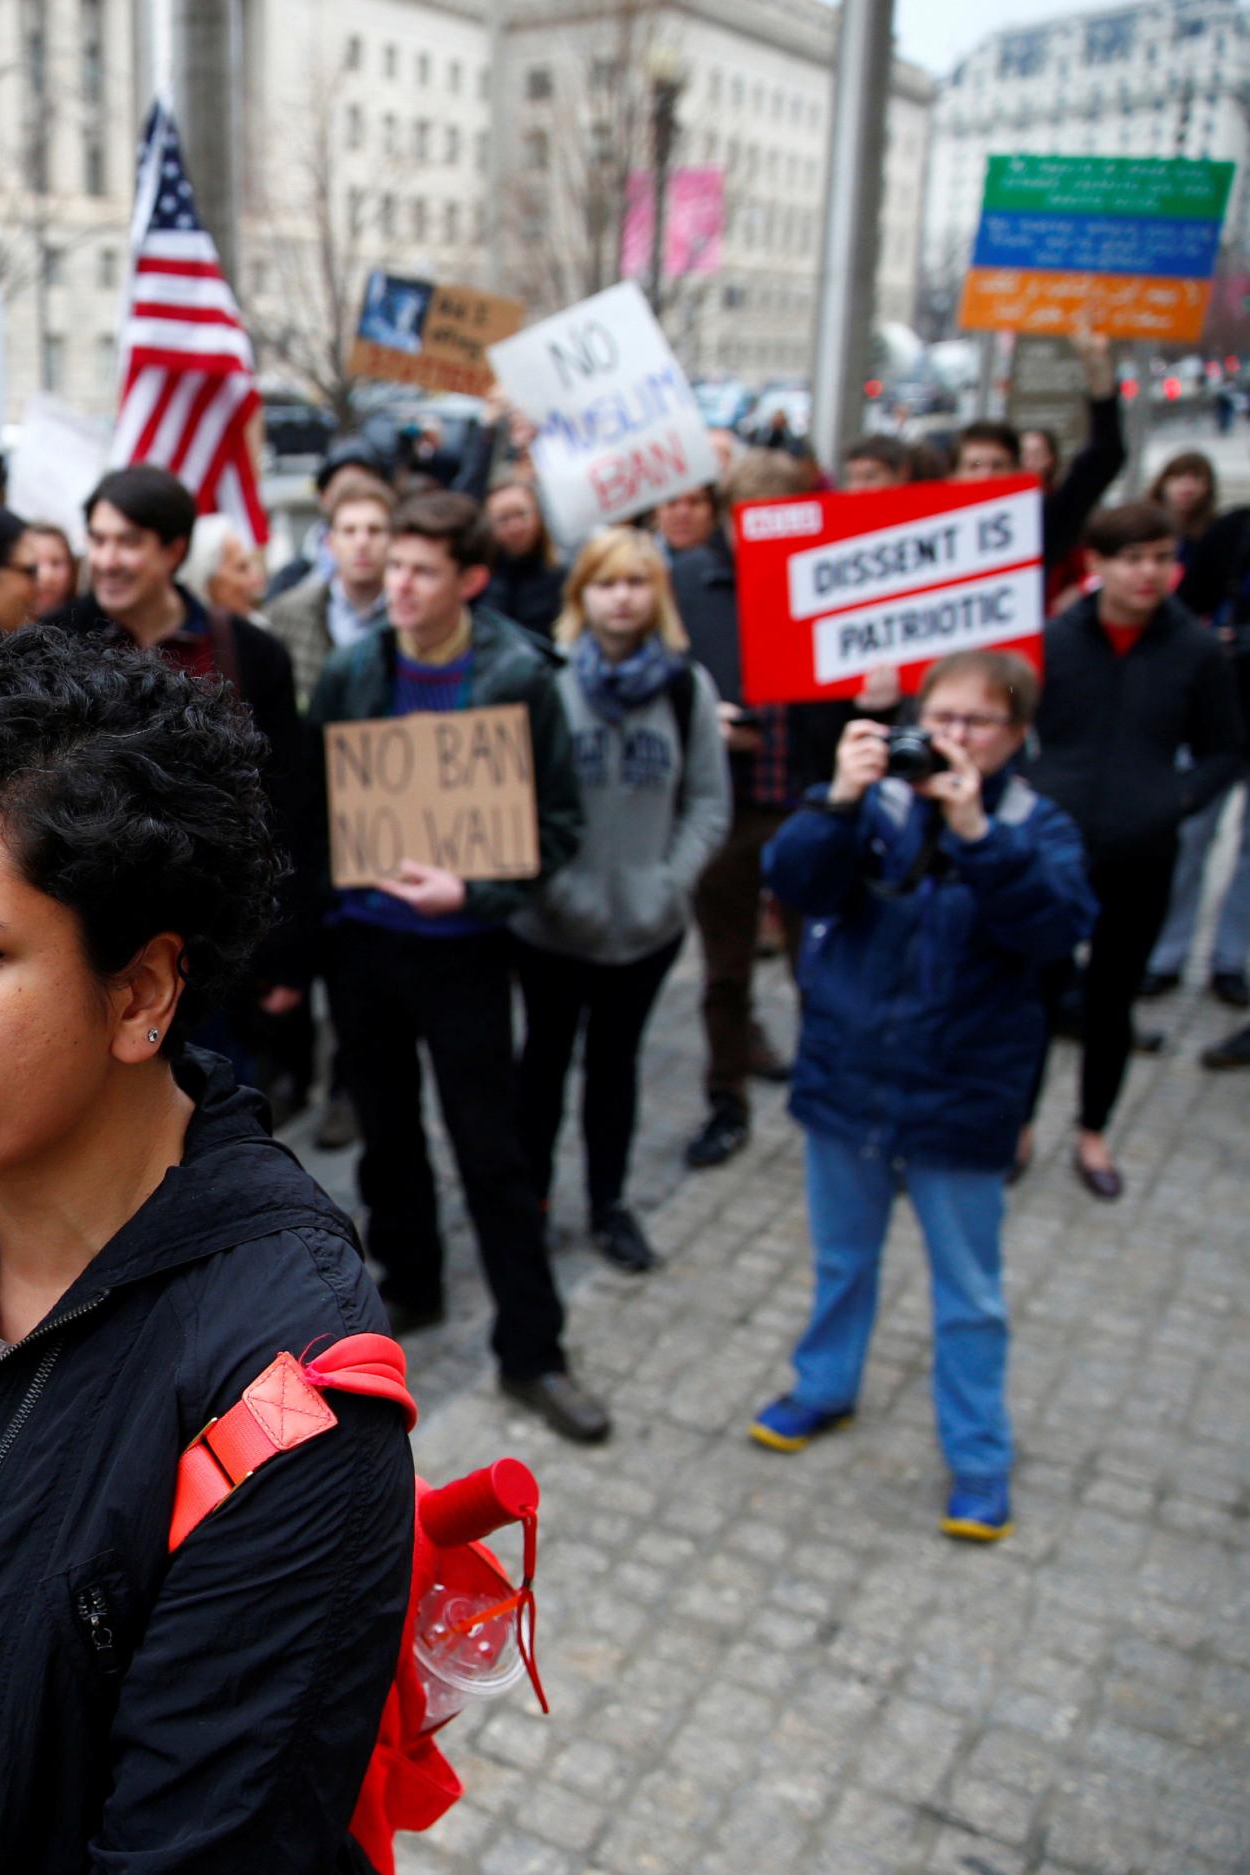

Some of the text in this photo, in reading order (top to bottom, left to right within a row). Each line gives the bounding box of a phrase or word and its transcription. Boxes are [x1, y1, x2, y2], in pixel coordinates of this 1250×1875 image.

[550, 319, 620, 390] NO
[541, 364, 687, 454] MUSLIM
[587, 430, 689, 513] BAN
[812, 511, 1013, 596] DISSENT IS
[838, 586, 1014, 660] PATRIOTIC
[334, 726, 414, 795] NO
[434, 719, 531, 790] BAN
[334, 805, 535, 877] NO WALL
